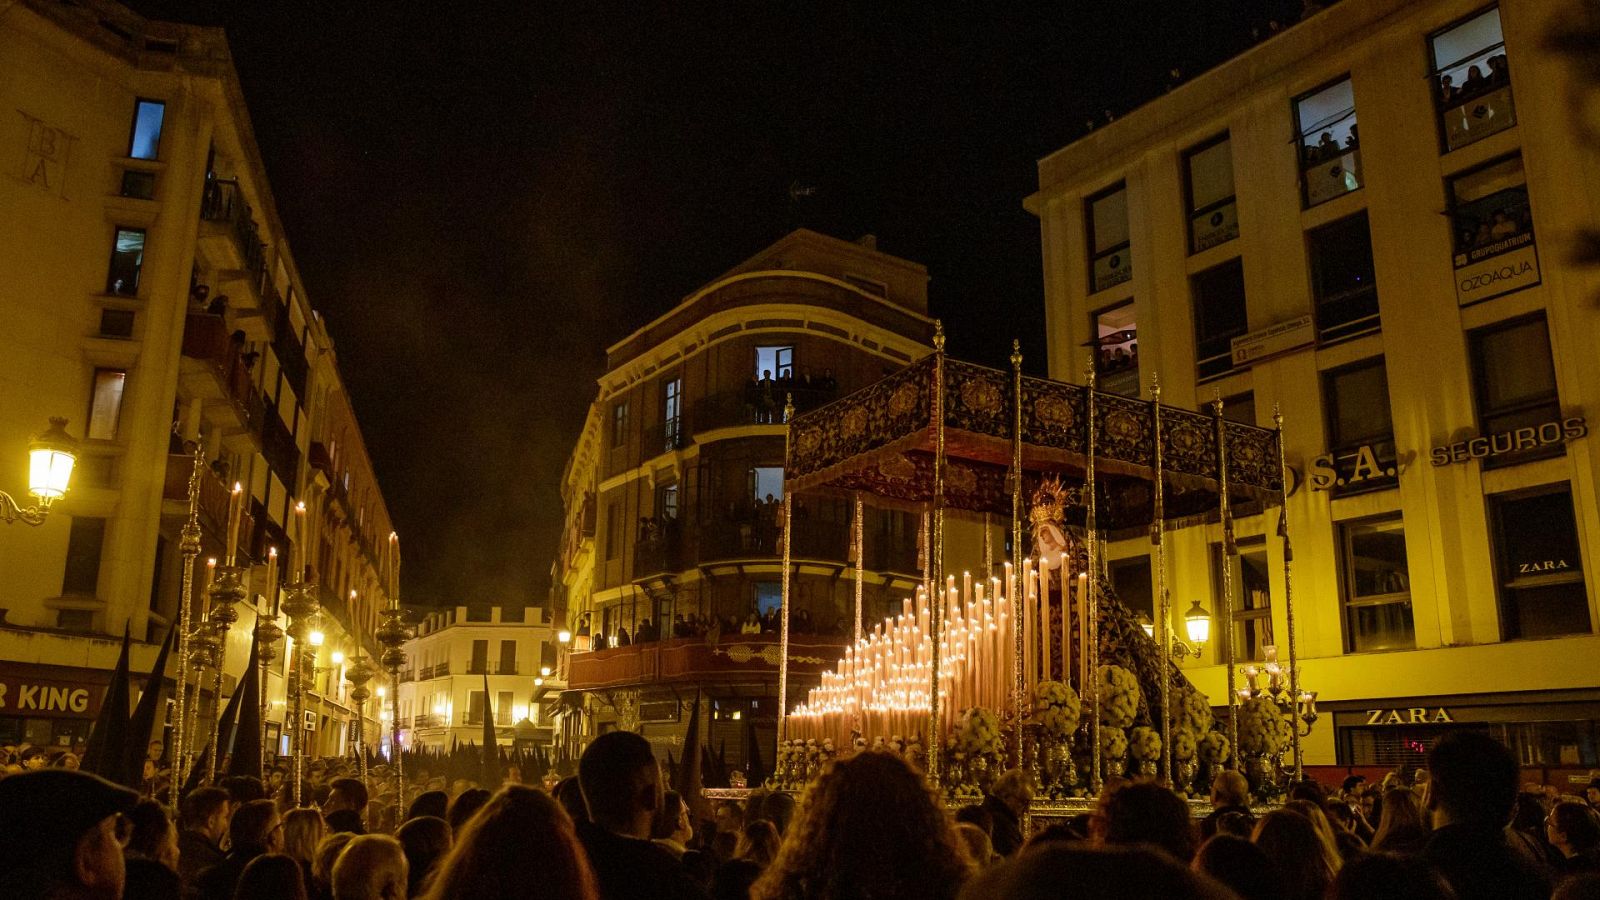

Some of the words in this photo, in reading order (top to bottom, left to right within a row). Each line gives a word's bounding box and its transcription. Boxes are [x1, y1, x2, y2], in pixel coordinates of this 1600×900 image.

[1461, 261, 1533, 292] OZOAQUA
[1430, 417, 1588, 466] SEGUROS
[1519, 559, 1569, 573] ZARA
[18, 684, 89, 712] KING
[1366, 707, 1454, 725] ZARA
